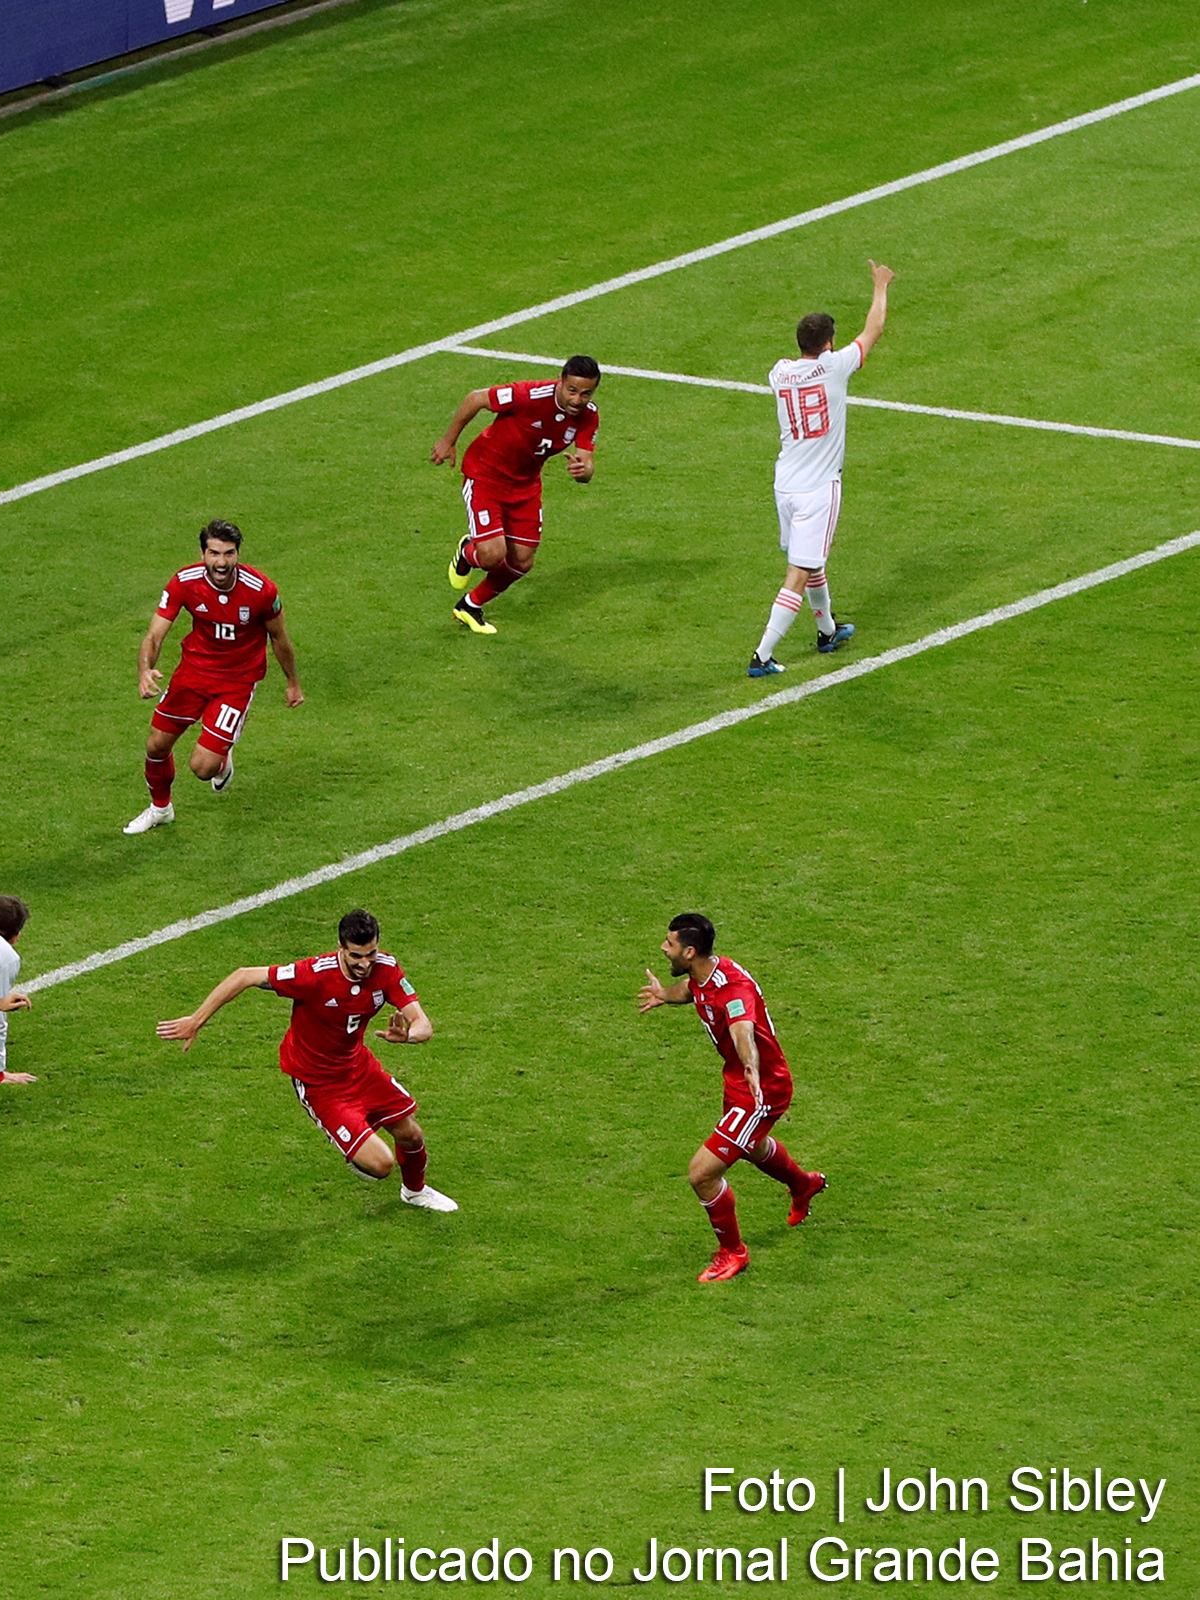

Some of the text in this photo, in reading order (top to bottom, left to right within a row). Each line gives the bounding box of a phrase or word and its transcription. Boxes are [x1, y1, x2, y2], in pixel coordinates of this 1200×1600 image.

[779, 384, 830, 439] 18
[214, 703, 241, 733] 10
[346, 1014, 362, 1035] 6
